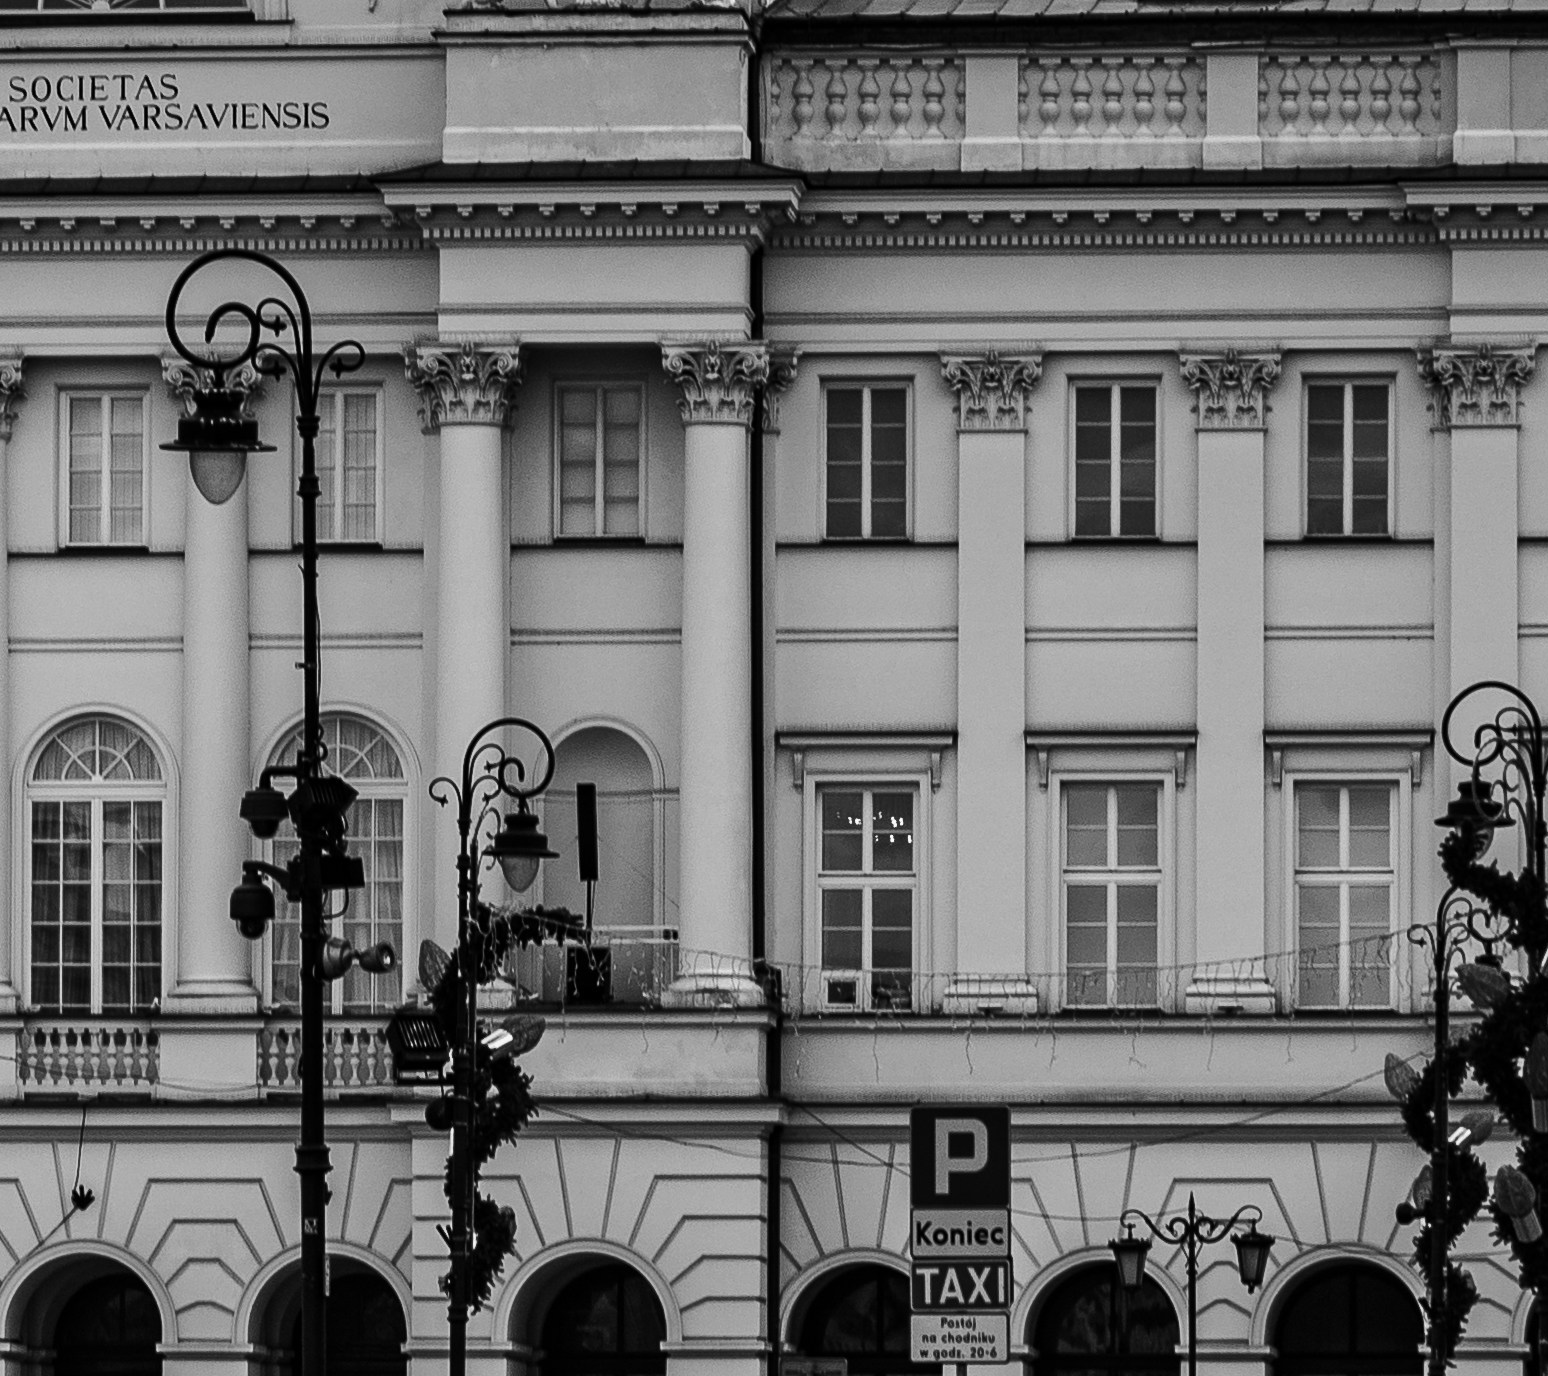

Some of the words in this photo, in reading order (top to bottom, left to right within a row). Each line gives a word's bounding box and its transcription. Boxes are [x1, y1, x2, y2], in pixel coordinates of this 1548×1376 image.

[9, 74, 179, 102] SOCIETAS
[97, 102, 330, 131] VARSAVIENSIS
[934, 1118, 988, 1195] P
[916, 1220, 1004, 1246] Koniec
[916, 1266, 1005, 1305] TAXI
[941, 1317, 977, 1331] Postój
[922, 1334, 937, 1344] na
[941, 1332, 996, 1344] chodniku
[919, 1349, 929, 1358] w
[933, 1347, 965, 1361] godz.
